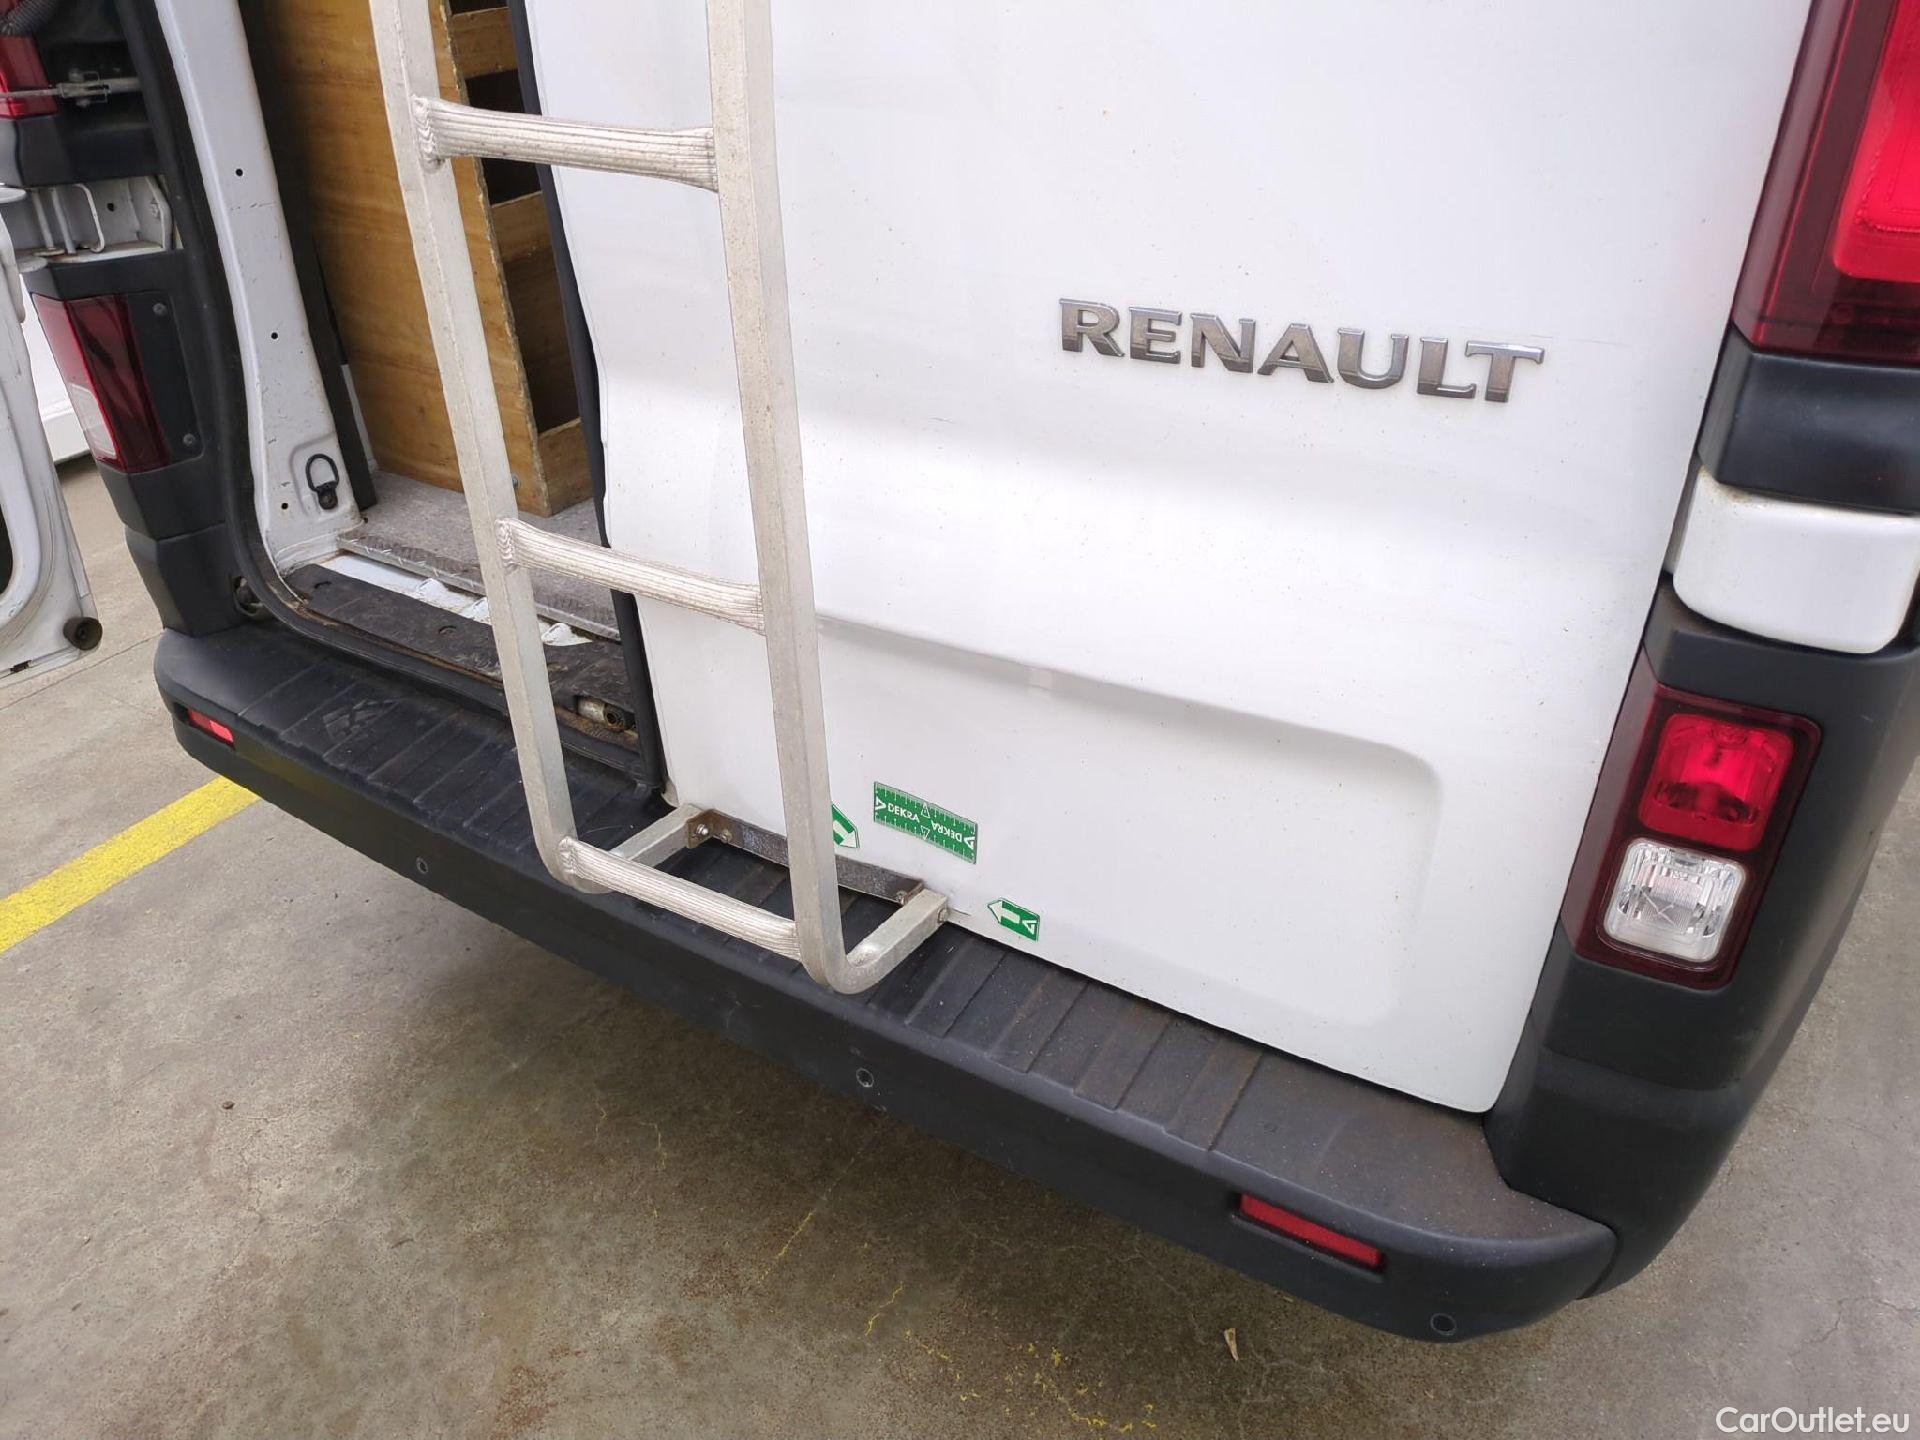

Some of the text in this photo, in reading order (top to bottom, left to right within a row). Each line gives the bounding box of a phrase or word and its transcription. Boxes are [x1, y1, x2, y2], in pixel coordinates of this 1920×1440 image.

[1060, 298, 1545, 403] RENAULT
[887, 803, 920, 822] DEKRA
[931, 820, 963, 842] DEKRA
